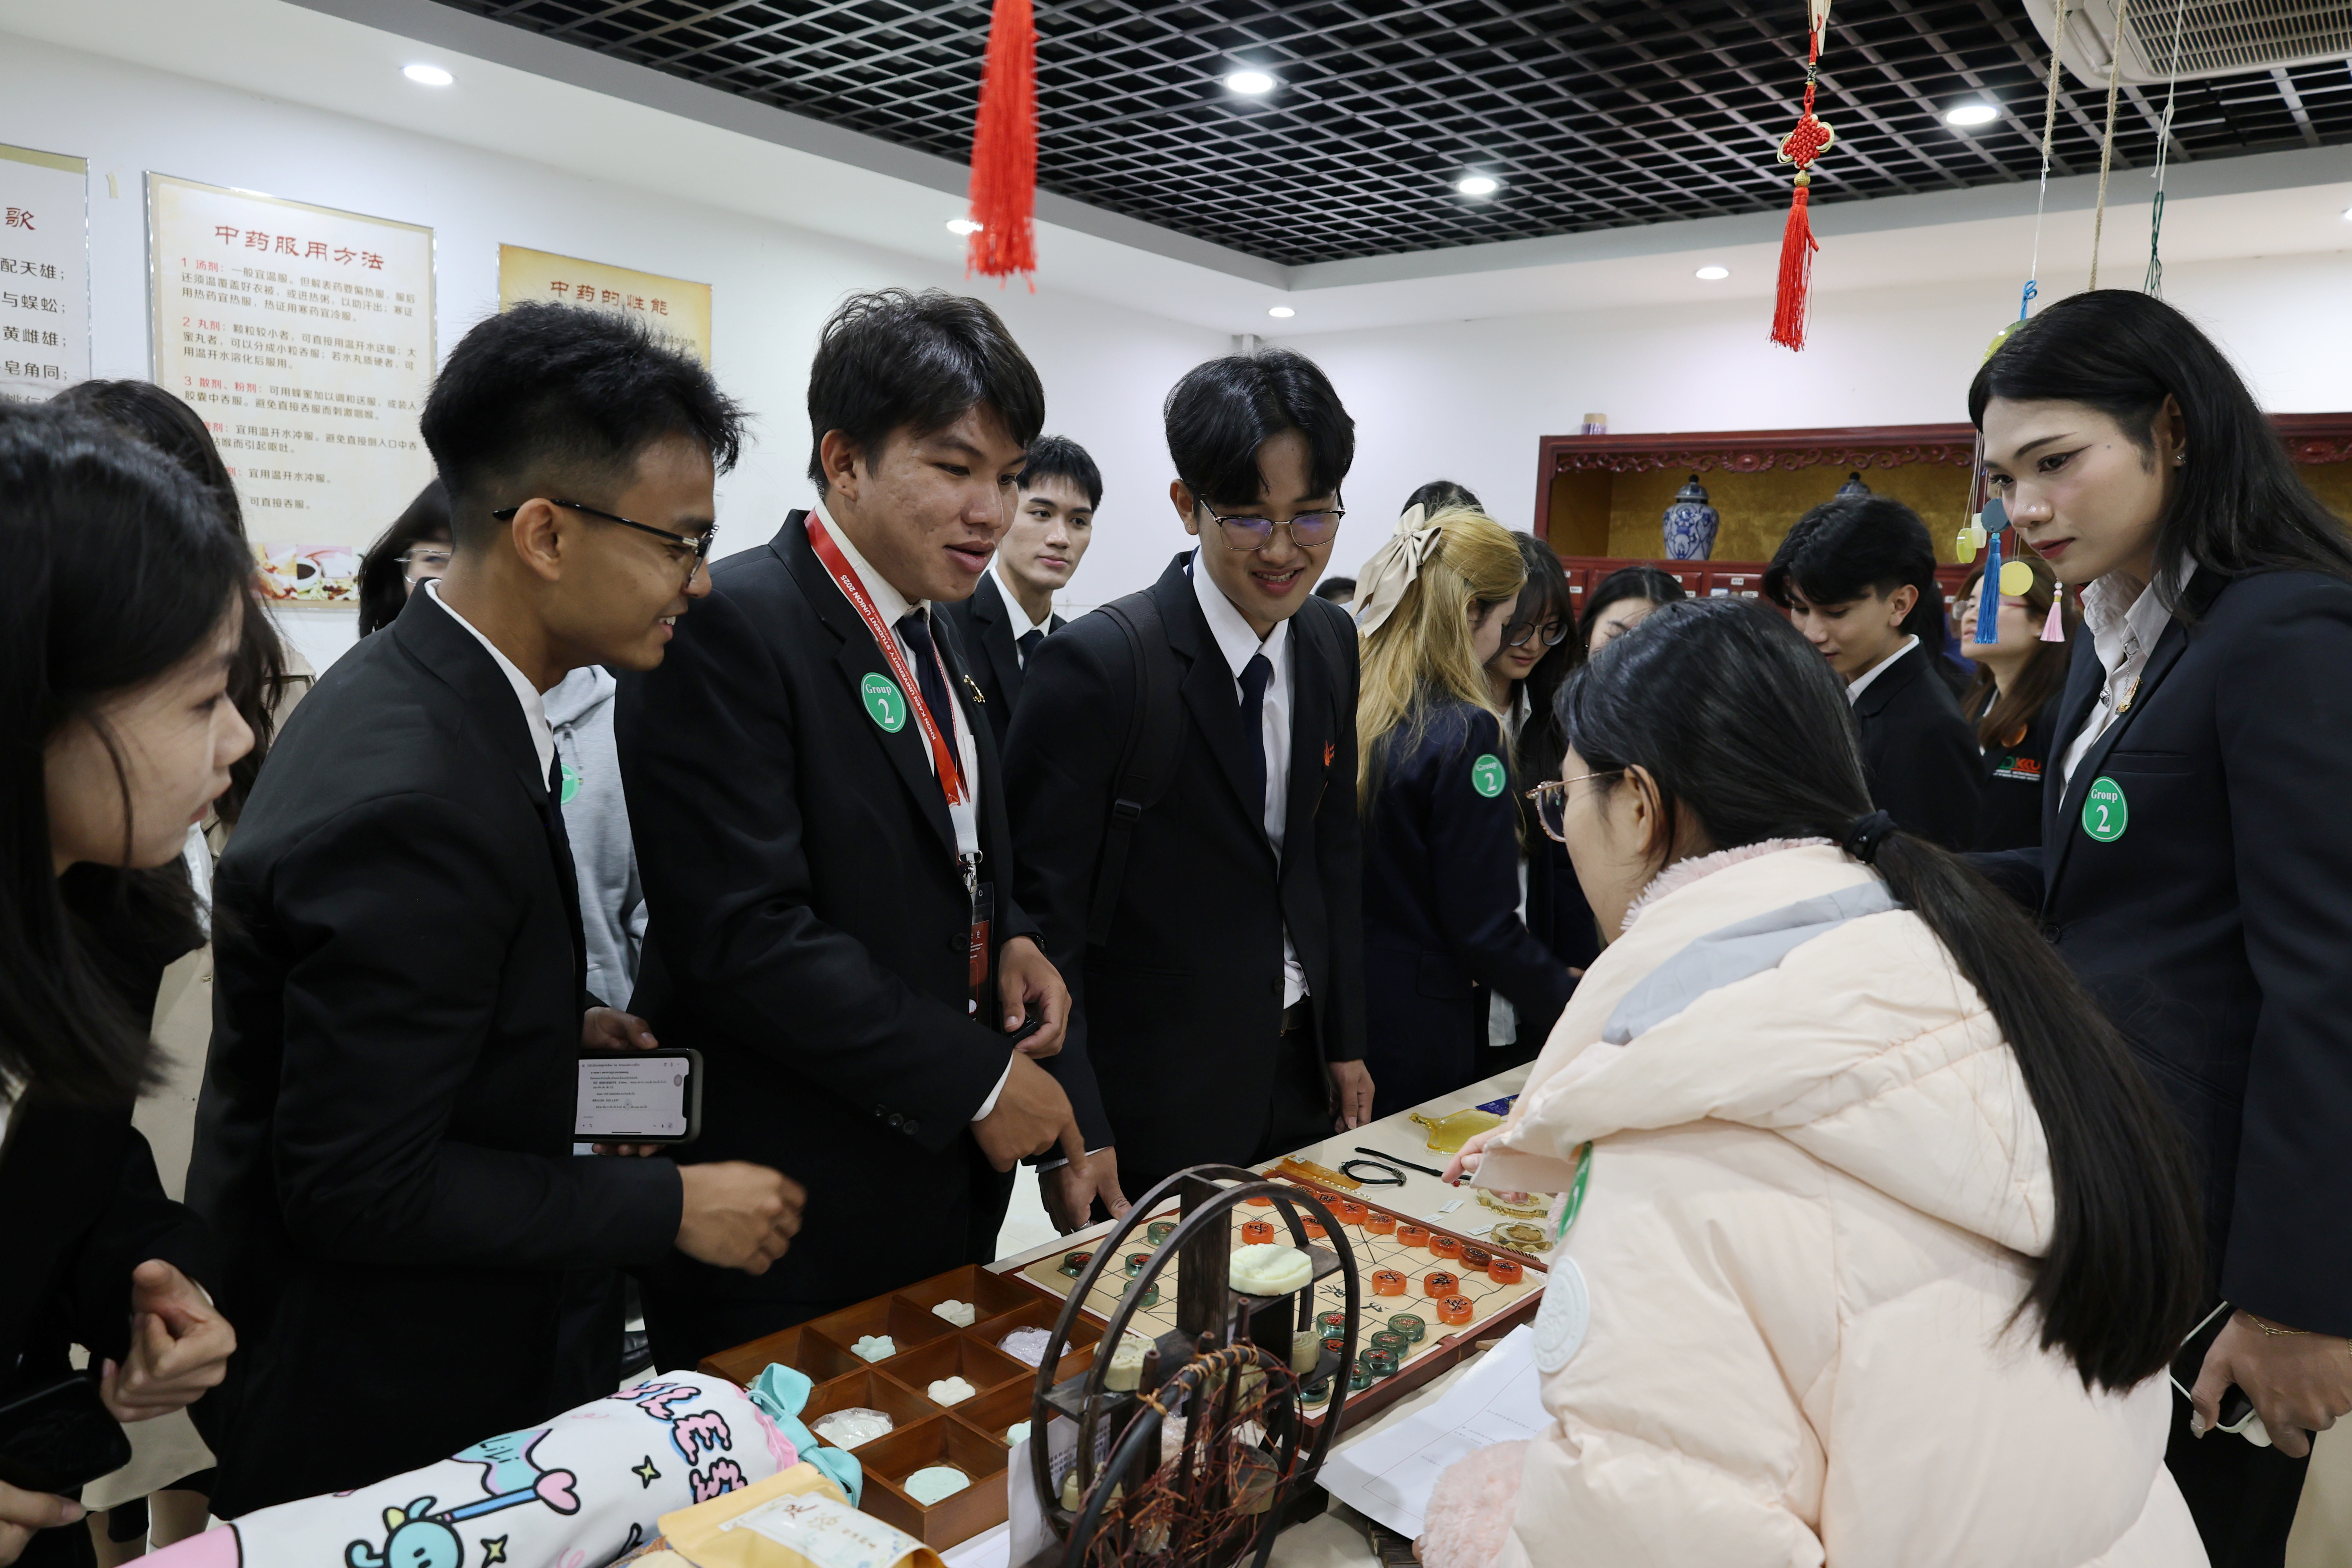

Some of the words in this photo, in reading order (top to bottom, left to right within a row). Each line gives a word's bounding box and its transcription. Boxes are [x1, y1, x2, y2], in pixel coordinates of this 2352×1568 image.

[5, 207, 36, 230] 歌
[215, 225, 384, 270] 中药服用方法
[181, 257, 187, 267] 1
[550, 280, 668, 316] 中药的性能
[183, 316, 190, 327] 2
[184, 346, 293, 369] 用温开水溶化后服用。
[184, 376, 192, 386] 3
[840, 575, 856, 592] 2025
[853, 592, 871, 616] UNION
[869, 617, 891, 651] STUDENT
[889, 652, 915, 695] UNIVERSITY
[866, 684, 892, 696] Group
[878, 698, 894, 724] 2
[913, 696, 926, 717] KAEN
[924, 718, 936, 740] KHON
[1484, 772, 1497, 791] 2
[2091, 789, 2118, 803] Group
[2096, 805, 2111, 832] 2
